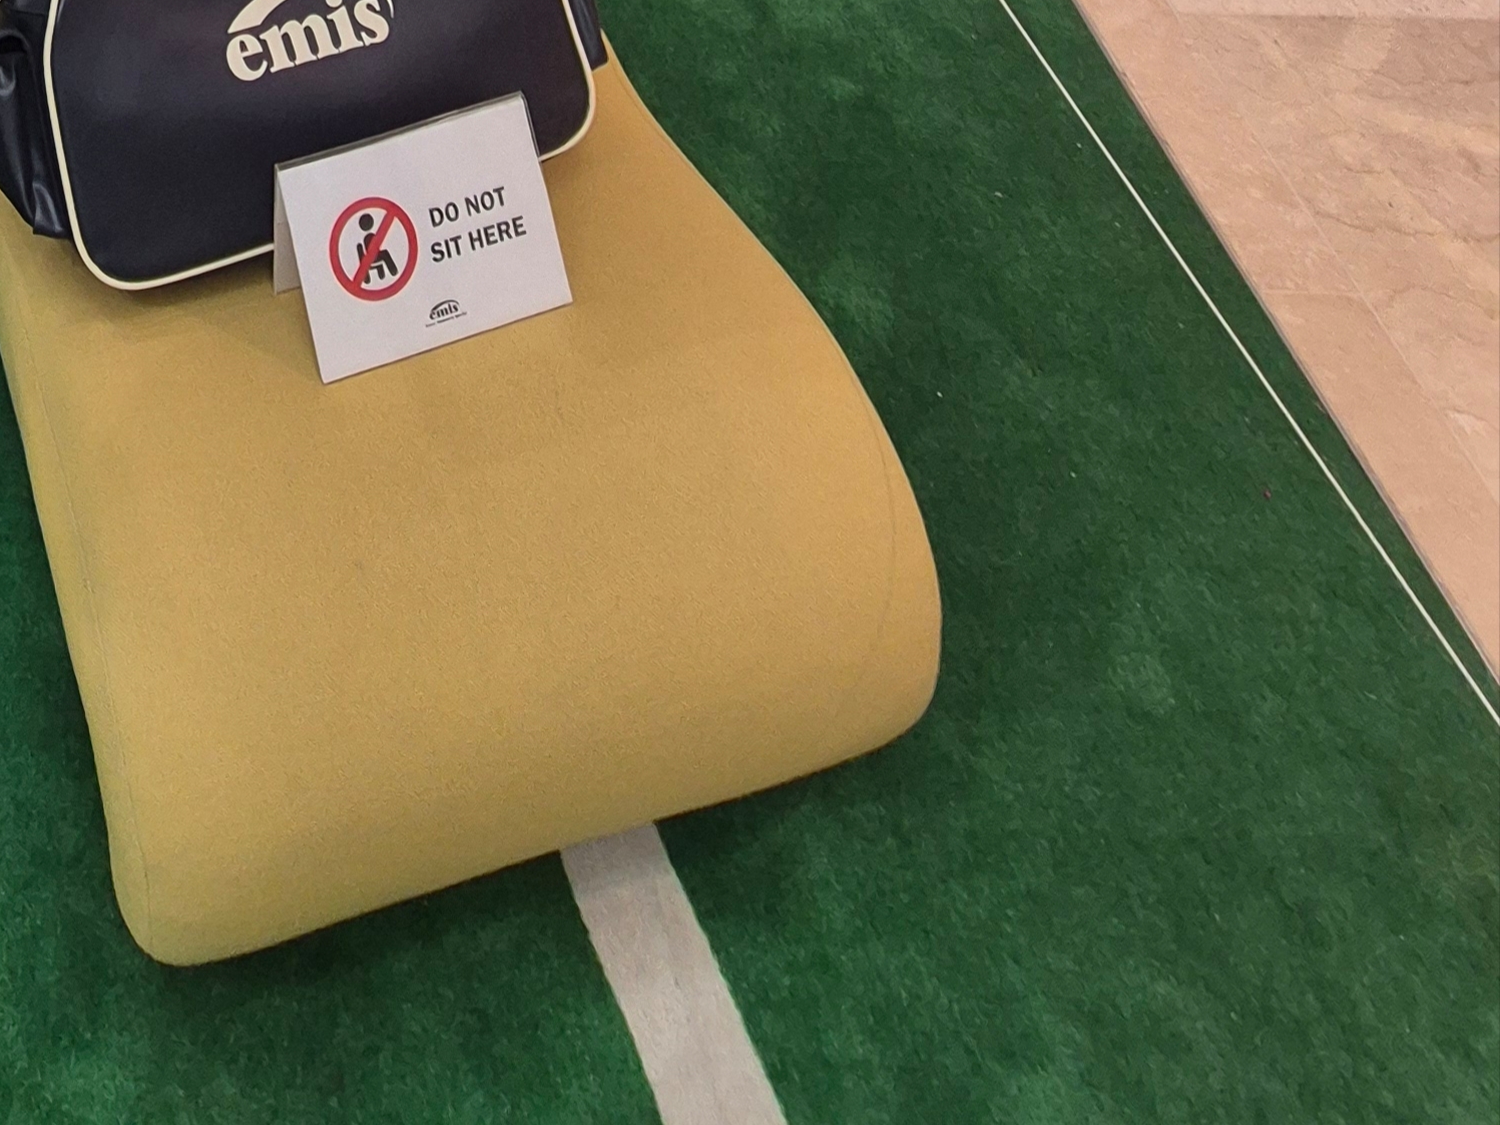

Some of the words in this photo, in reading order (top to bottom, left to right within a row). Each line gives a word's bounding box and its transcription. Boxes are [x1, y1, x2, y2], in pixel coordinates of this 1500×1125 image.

[428, 201, 460, 228] DO
[464, 186, 505, 217] NOT
[430, 235, 462, 263] SIT
[468, 215, 527, 251] HERE
[429, 302, 459, 320] emis
